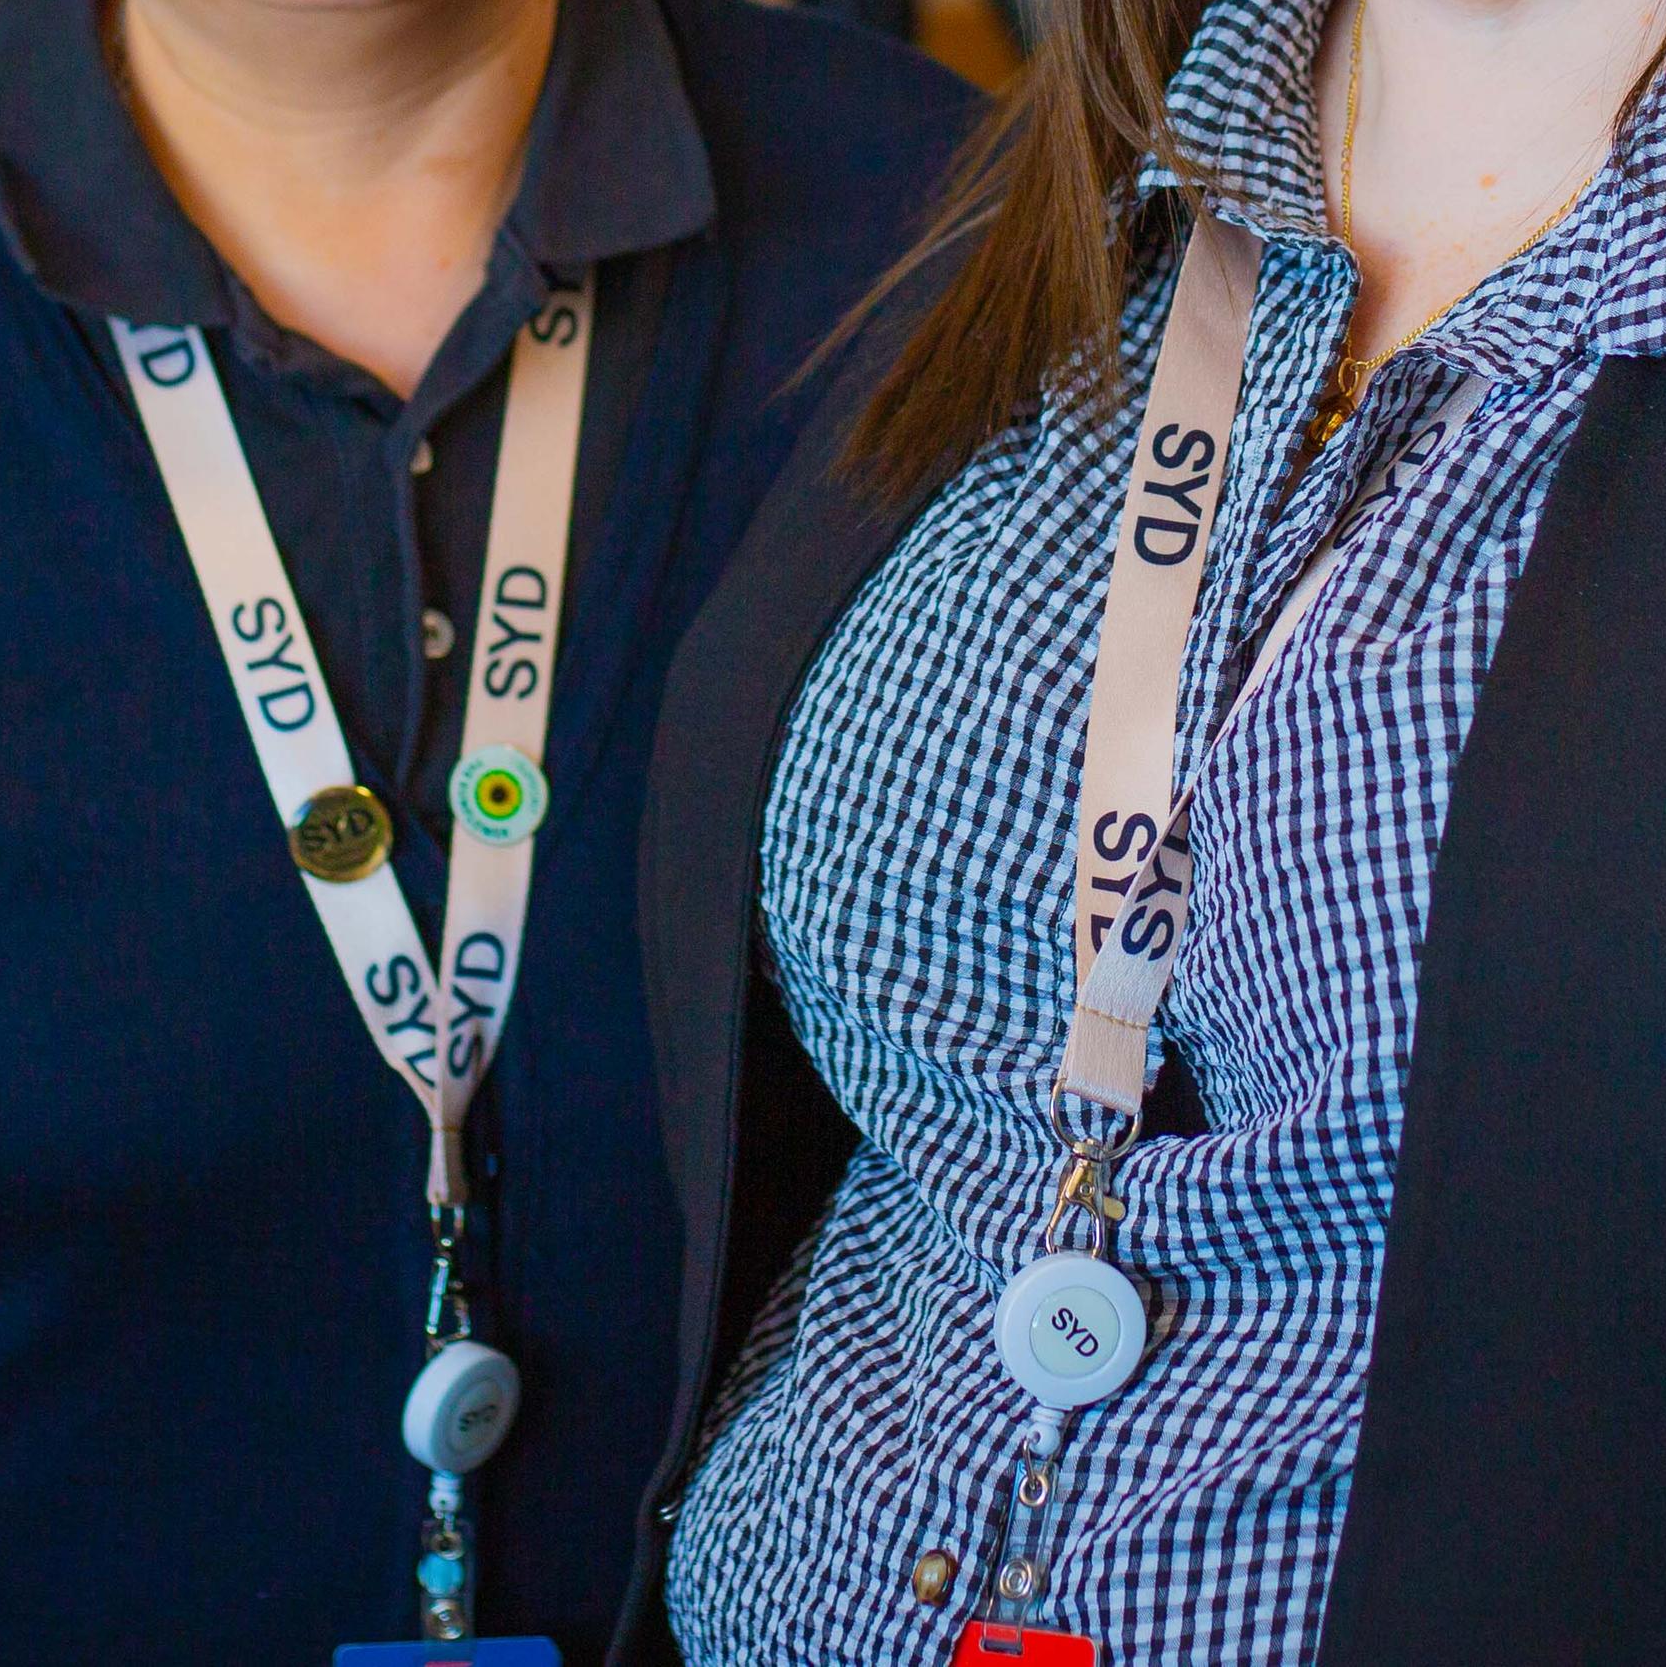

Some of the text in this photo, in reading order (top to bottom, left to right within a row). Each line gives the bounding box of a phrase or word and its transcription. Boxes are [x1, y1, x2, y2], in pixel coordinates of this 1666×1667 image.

[1134, 422, 1215, 567] SYD
[232, 597, 316, 733] SYD
[484, 566, 549, 701] SYD
[448, 931, 507, 1079] SYD
[1050, 1307, 1100, 1358] SYD
